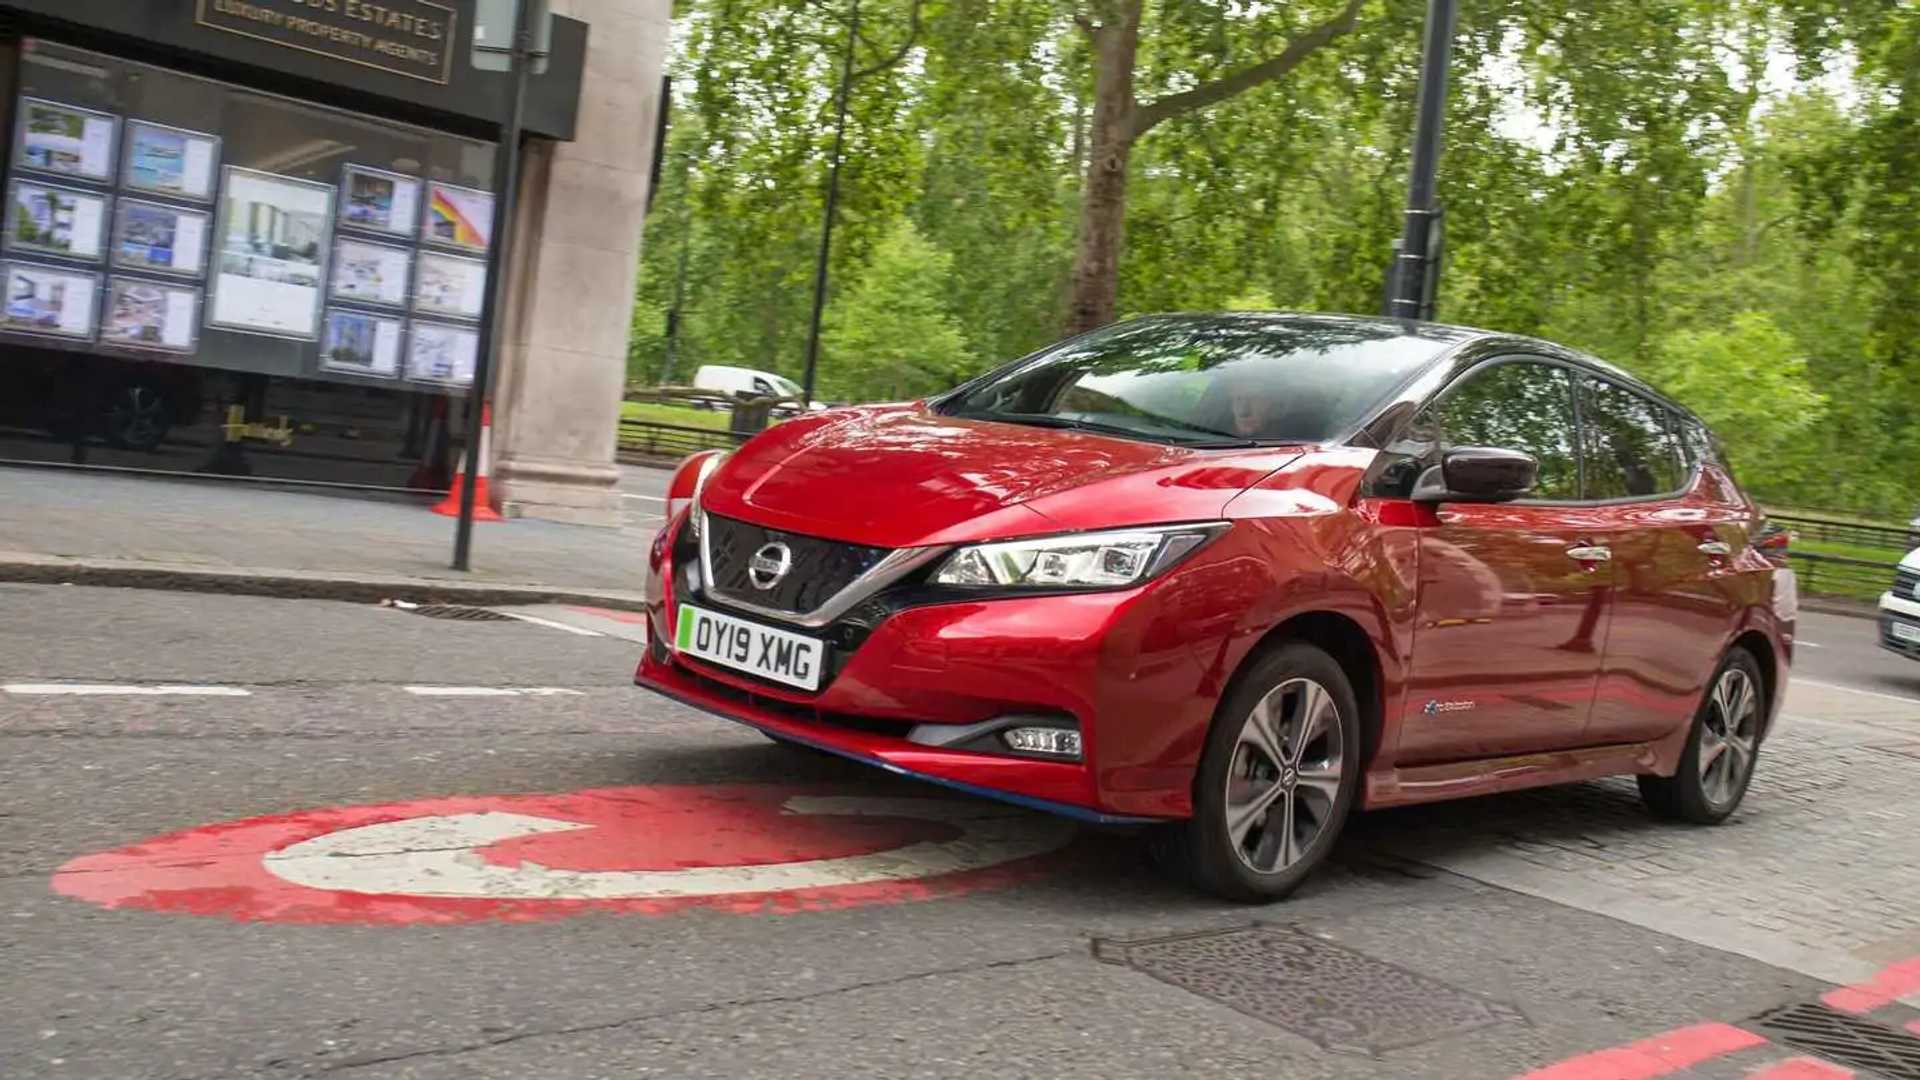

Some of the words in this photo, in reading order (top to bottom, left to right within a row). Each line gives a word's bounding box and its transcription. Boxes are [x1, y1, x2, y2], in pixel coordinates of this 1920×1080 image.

[287, 16, 371, 49] PROPERTY
[372, 39, 438, 65] AGENTS
[344, 0, 442, 39] ESTATES
[697, 616, 750, 663] OY19
[757, 633, 811, 679] XMG
